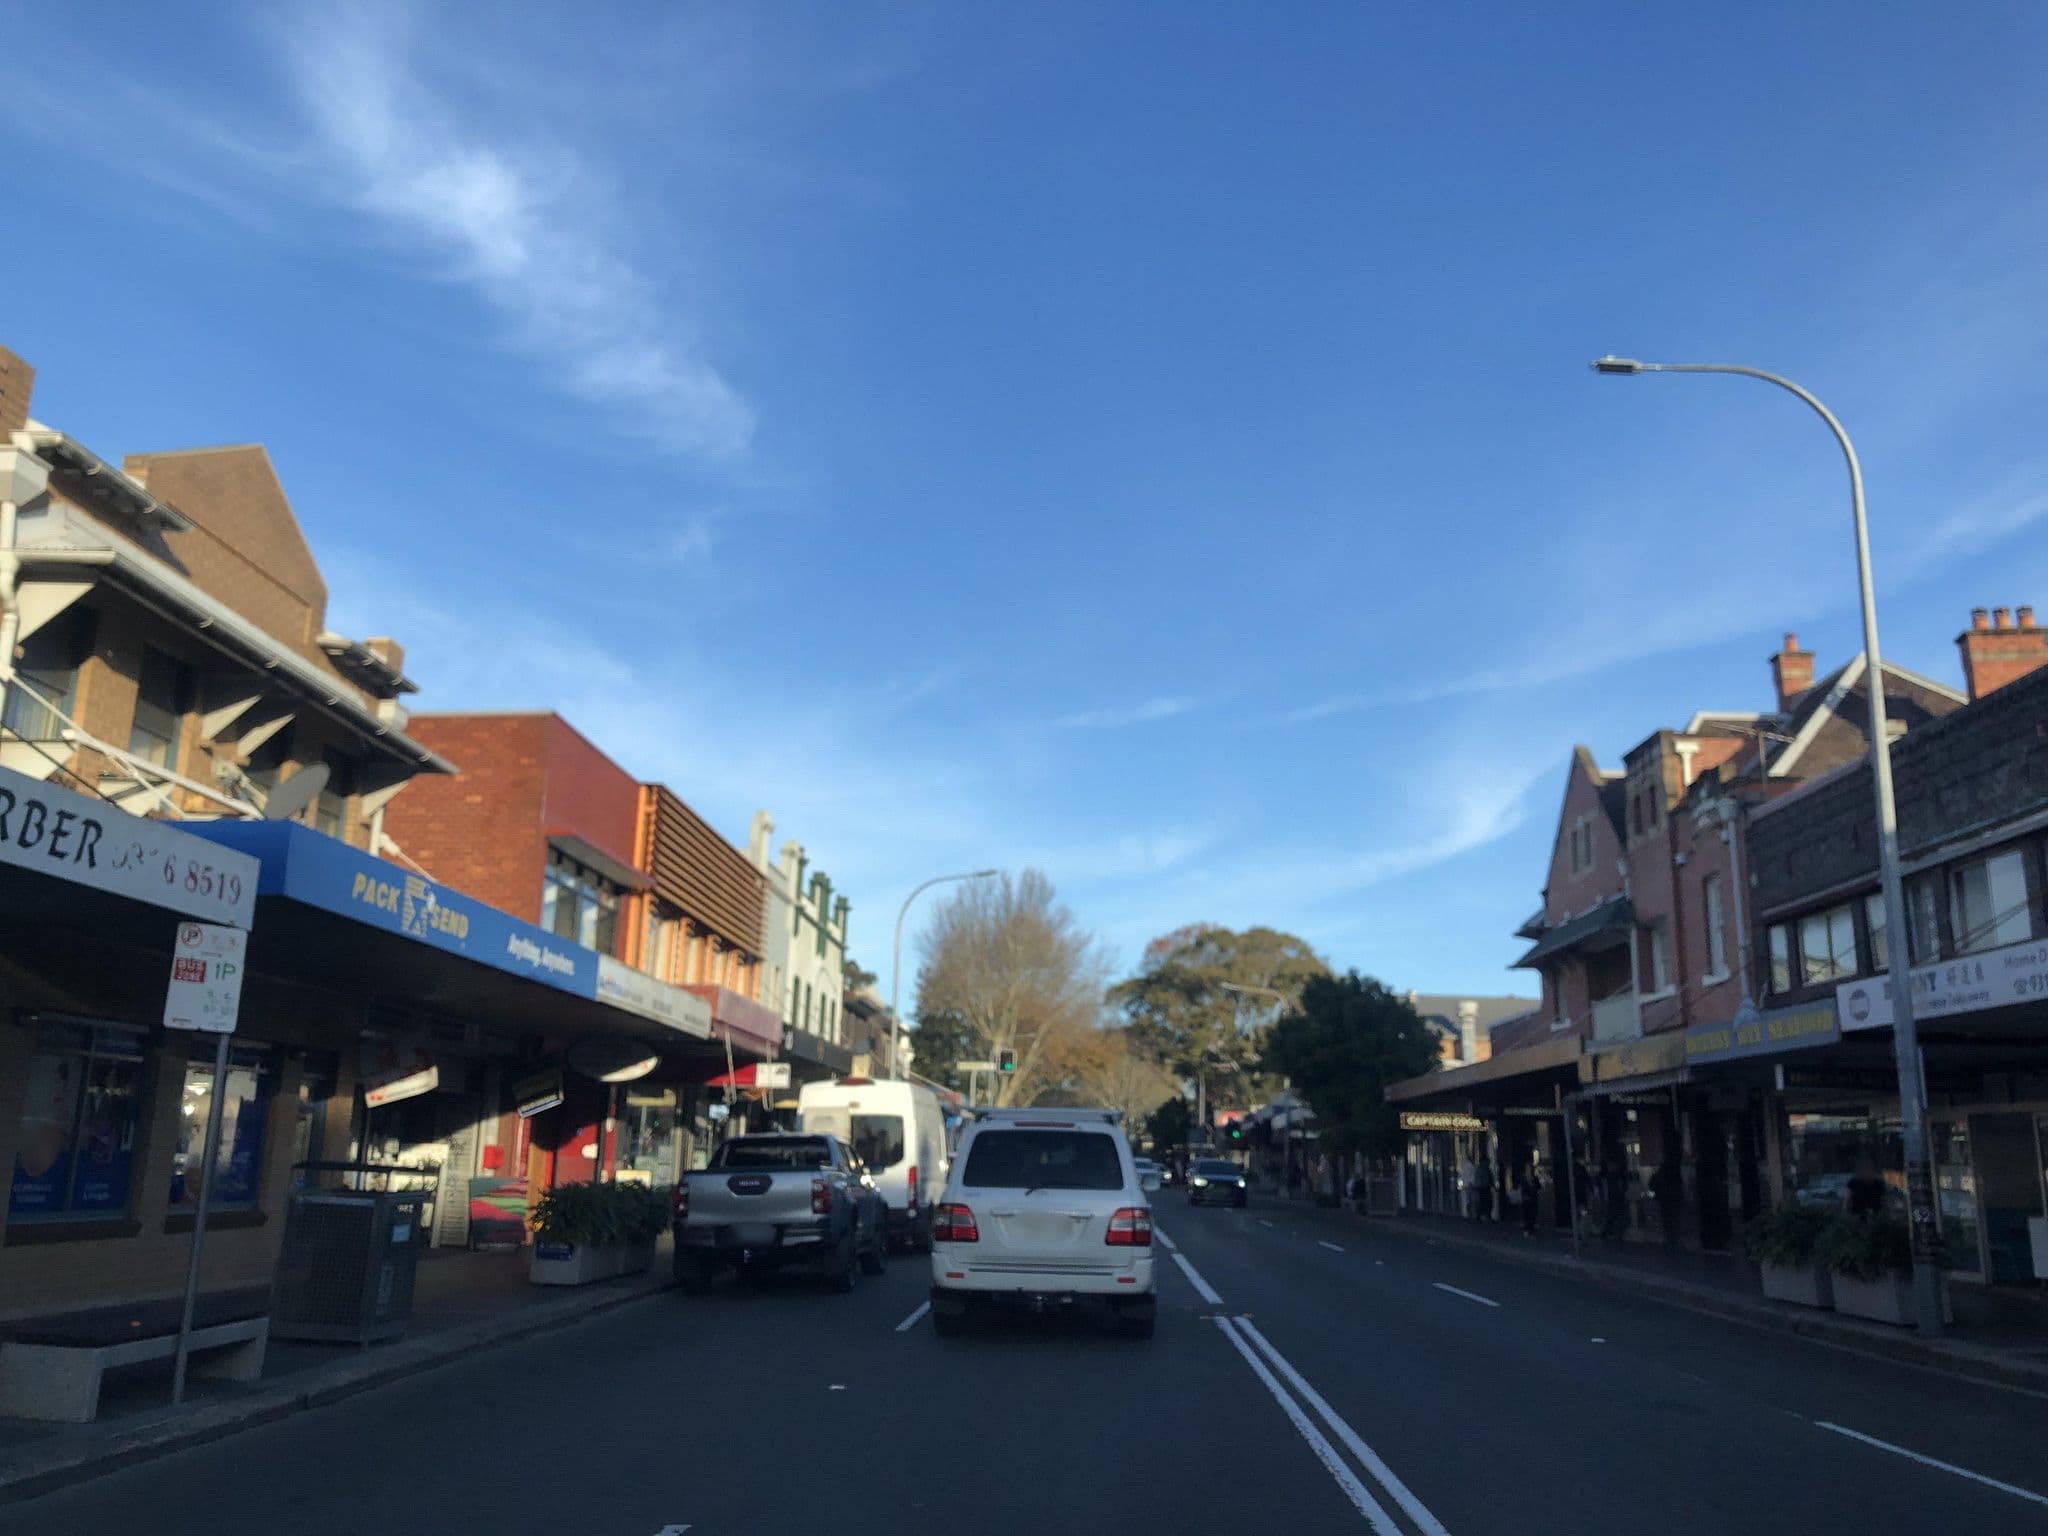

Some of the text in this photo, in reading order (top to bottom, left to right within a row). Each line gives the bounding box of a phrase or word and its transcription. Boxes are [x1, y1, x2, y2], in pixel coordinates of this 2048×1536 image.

[184, 859, 242, 905] 8519
[351, 872, 470, 939] PACK SEND
